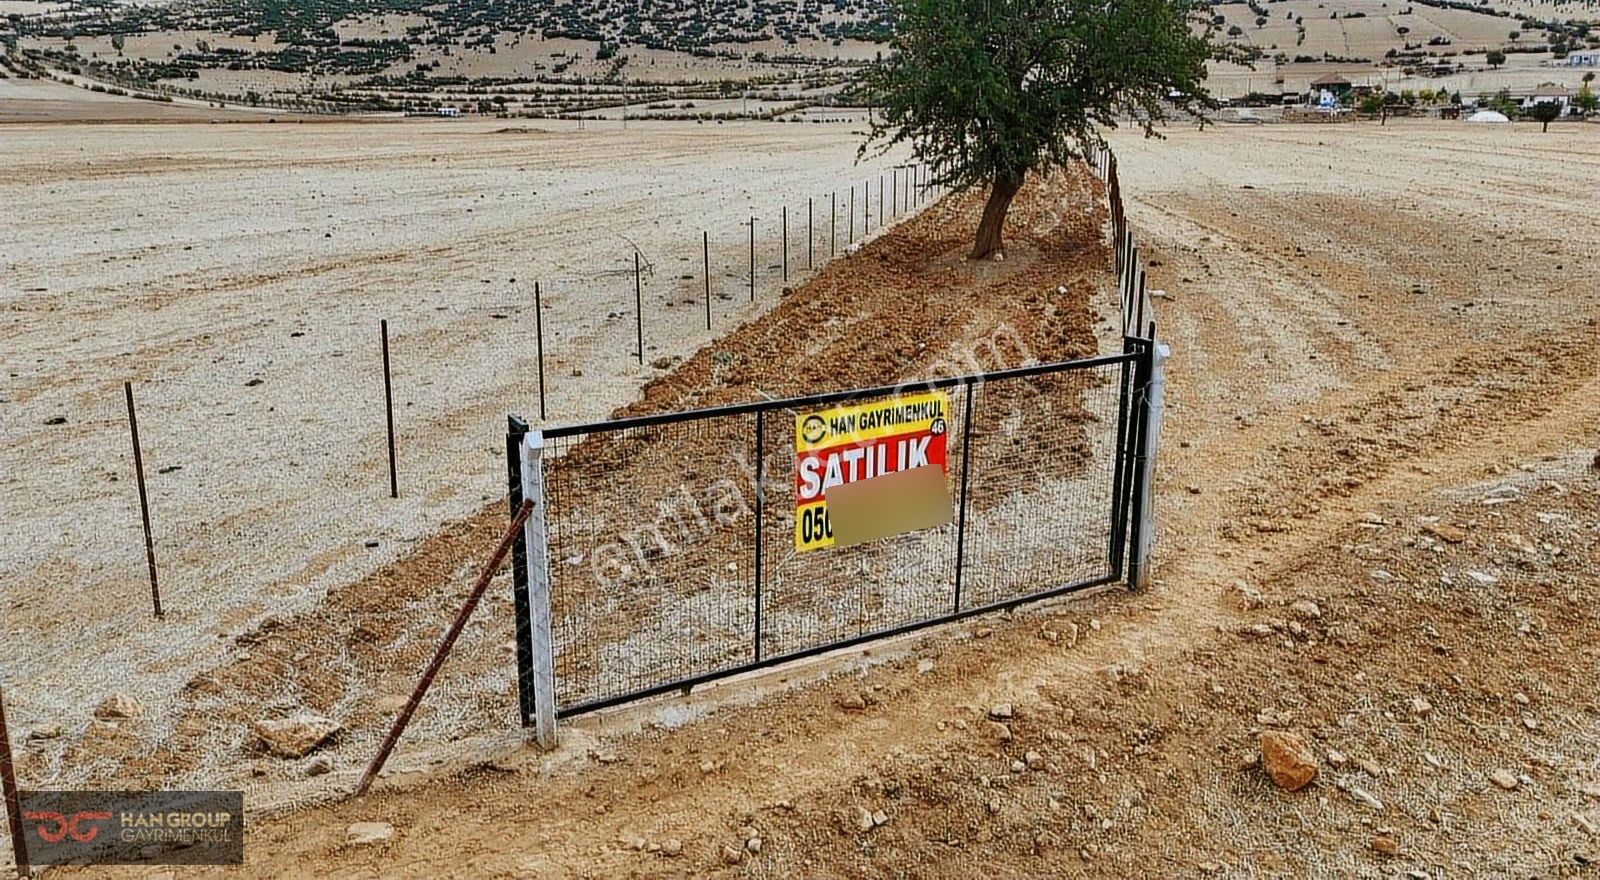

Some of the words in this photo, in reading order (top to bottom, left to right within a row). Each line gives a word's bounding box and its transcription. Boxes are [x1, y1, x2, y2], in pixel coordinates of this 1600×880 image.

[830, 415, 856, 437] HAN
[931, 420, 945, 434] 46
[800, 435, 933, 499] SATILIK
